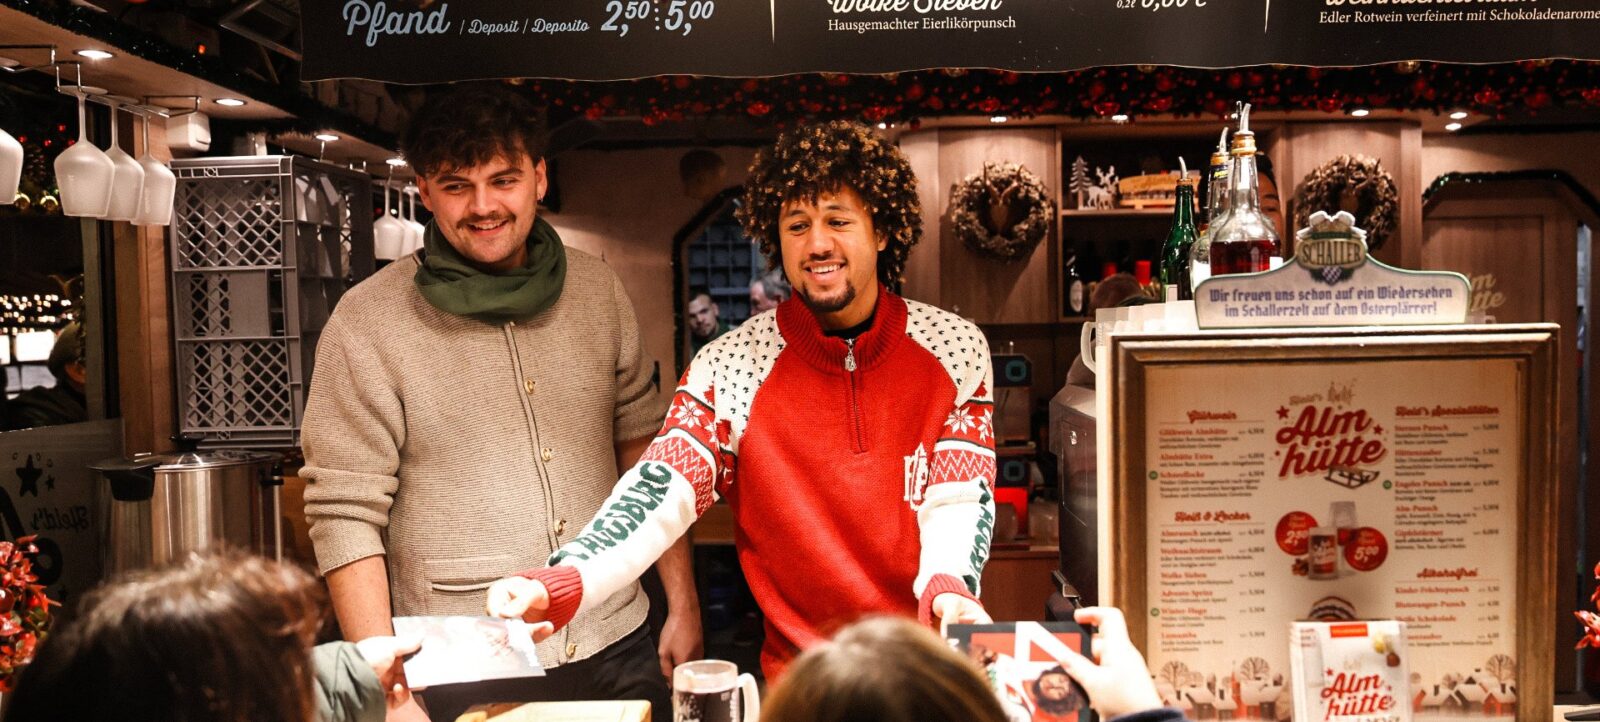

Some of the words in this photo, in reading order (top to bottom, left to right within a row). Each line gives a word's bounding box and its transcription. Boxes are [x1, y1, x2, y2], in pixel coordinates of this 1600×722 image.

[342, 0, 451, 47] Pfand
[468, 19, 520, 36] Deposit
[531, 18, 590, 35] Deposito
[828, 18, 919, 34] Hausgemachter
[922, 16, 1016, 32] Eierlikörpunsch
[1320, 11, 1351, 23] Edler
[1355, 11, 1402, 22] Rotwein
[1406, 9, 1462, 22] verfeinert
[1466, 9, 1486, 21] mit
[1490, 8, 1600, 21] Schokoladenarome
[1209, 289, 1230, 303] Wir
[1233, 289, 1271, 303] freuen
[1275, 290, 1294, 303] uns
[1298, 288, 1333, 302] schon
[1335, 287, 1353, 301] auf
[1357, 288, 1374, 301] ein
[1377, 286, 1453, 300] Wiedersehen
[1225, 304, 1239, 317] im
[1242, 302, 1310, 317] Schallerzelt
[1312, 303, 1331, 316] auf
[1334, 302, 1357, 316] dem
[1276, 405, 1372, 446] Alm
[1279, 436, 1386, 478] hütte
[1320, 672, 1384, 699] Alm
[1325, 693, 1396, 721] hütte
